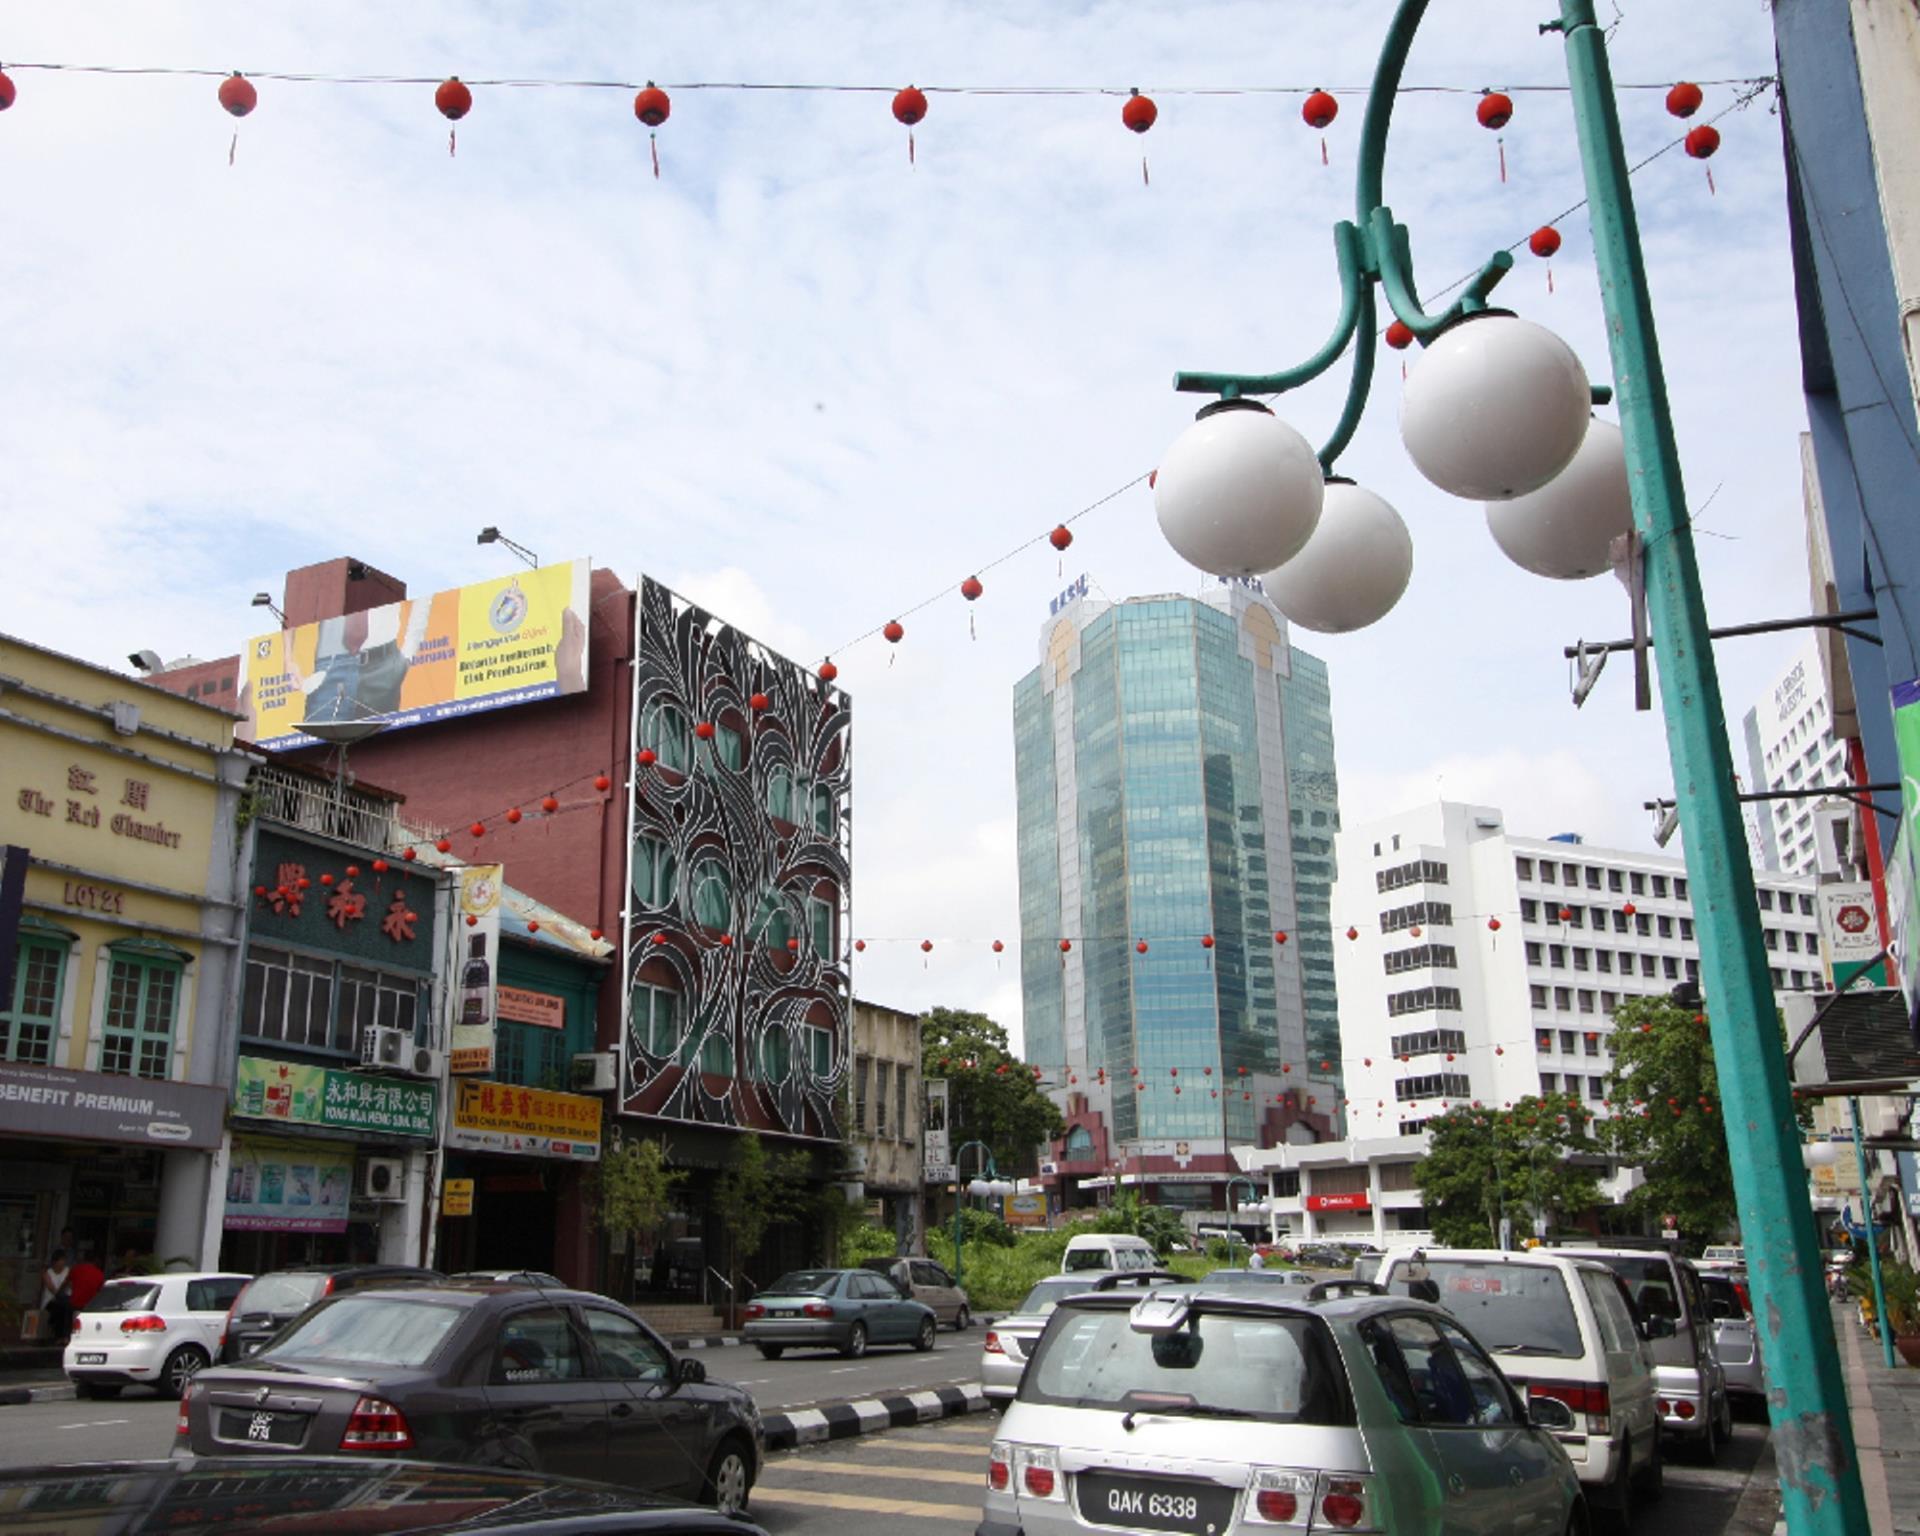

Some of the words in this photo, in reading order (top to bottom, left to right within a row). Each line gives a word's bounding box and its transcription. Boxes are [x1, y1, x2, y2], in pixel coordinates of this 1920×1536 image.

[18, 789, 55, 817] The
[65, 798, 101, 829] Red
[111, 813, 181, 849] Chamber
[74, 1092, 154, 1116] PREMIUM
[1108, 1488, 1144, 1514] QAK
[1149, 1493, 1198, 1520] 6338
